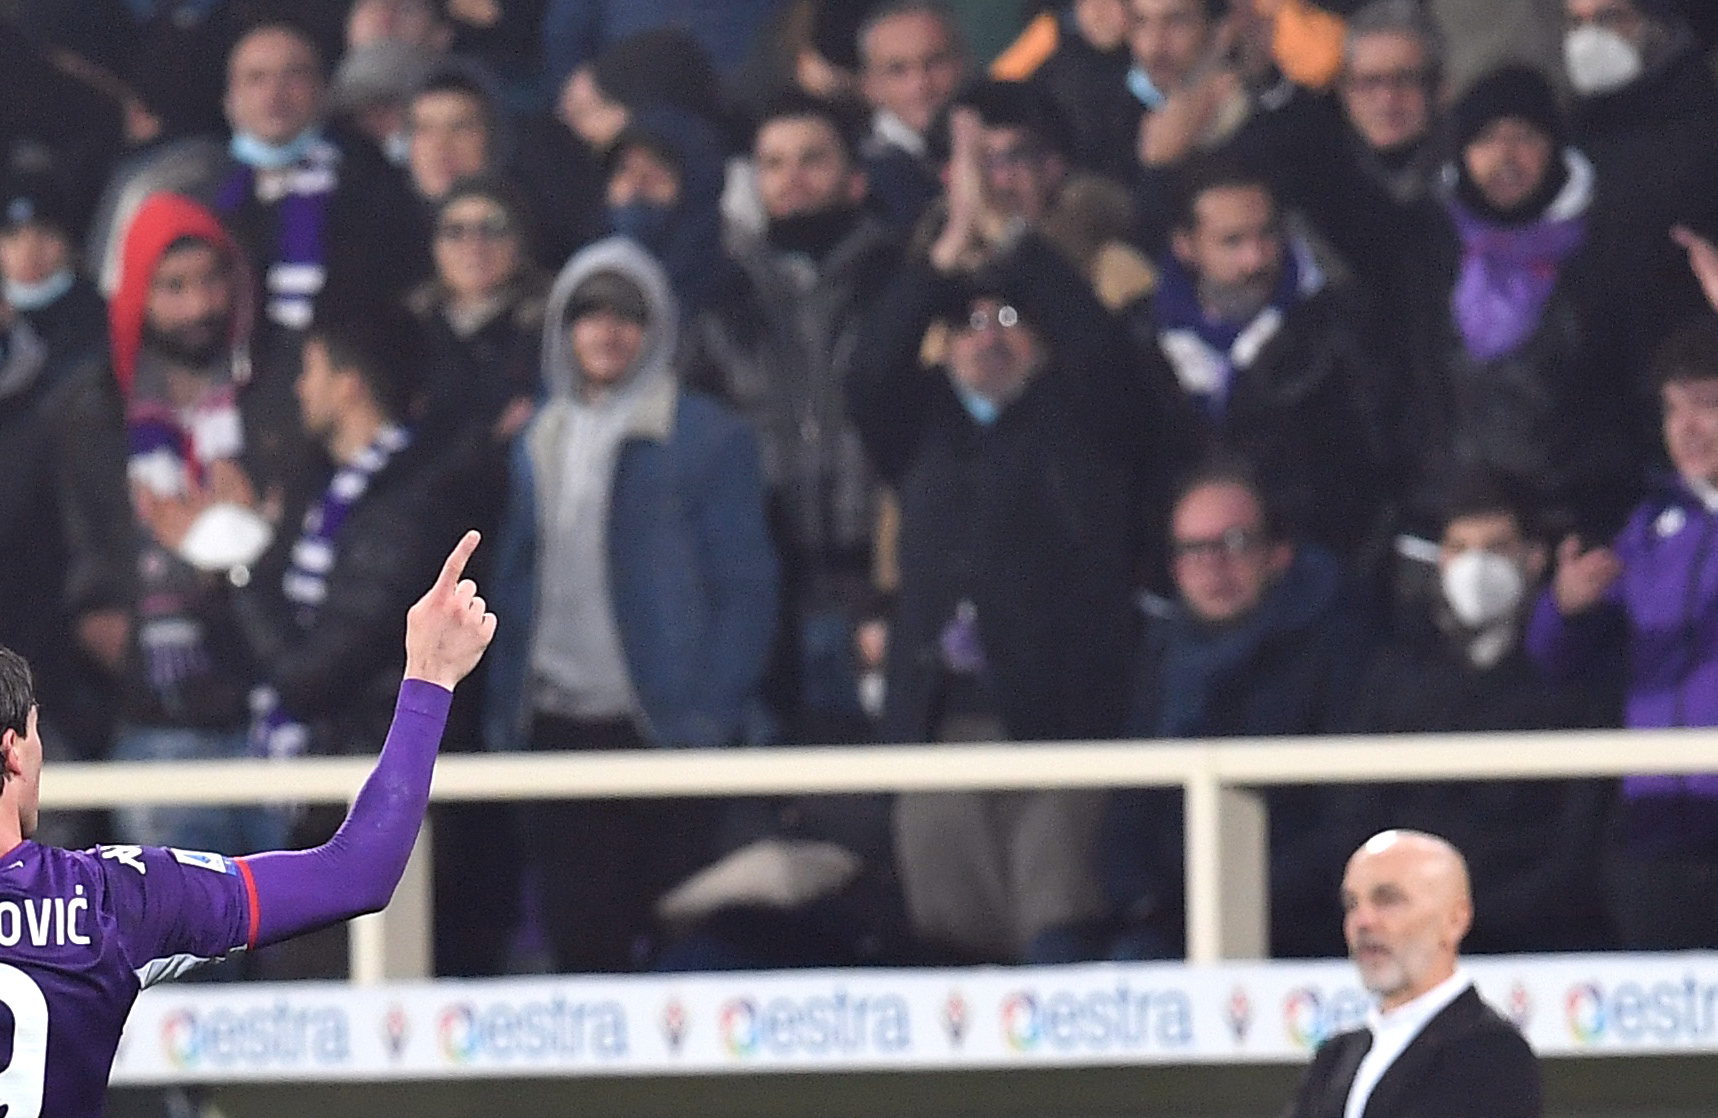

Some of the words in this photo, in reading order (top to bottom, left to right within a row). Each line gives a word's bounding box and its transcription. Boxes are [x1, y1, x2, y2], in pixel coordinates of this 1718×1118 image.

[209, 996, 351, 1064] estra
[489, 990, 630, 1060] estra
[762, 984, 912, 1055] estra
[1032, 980, 1193, 1044] estra
[1612, 975, 1718, 1042] estr
